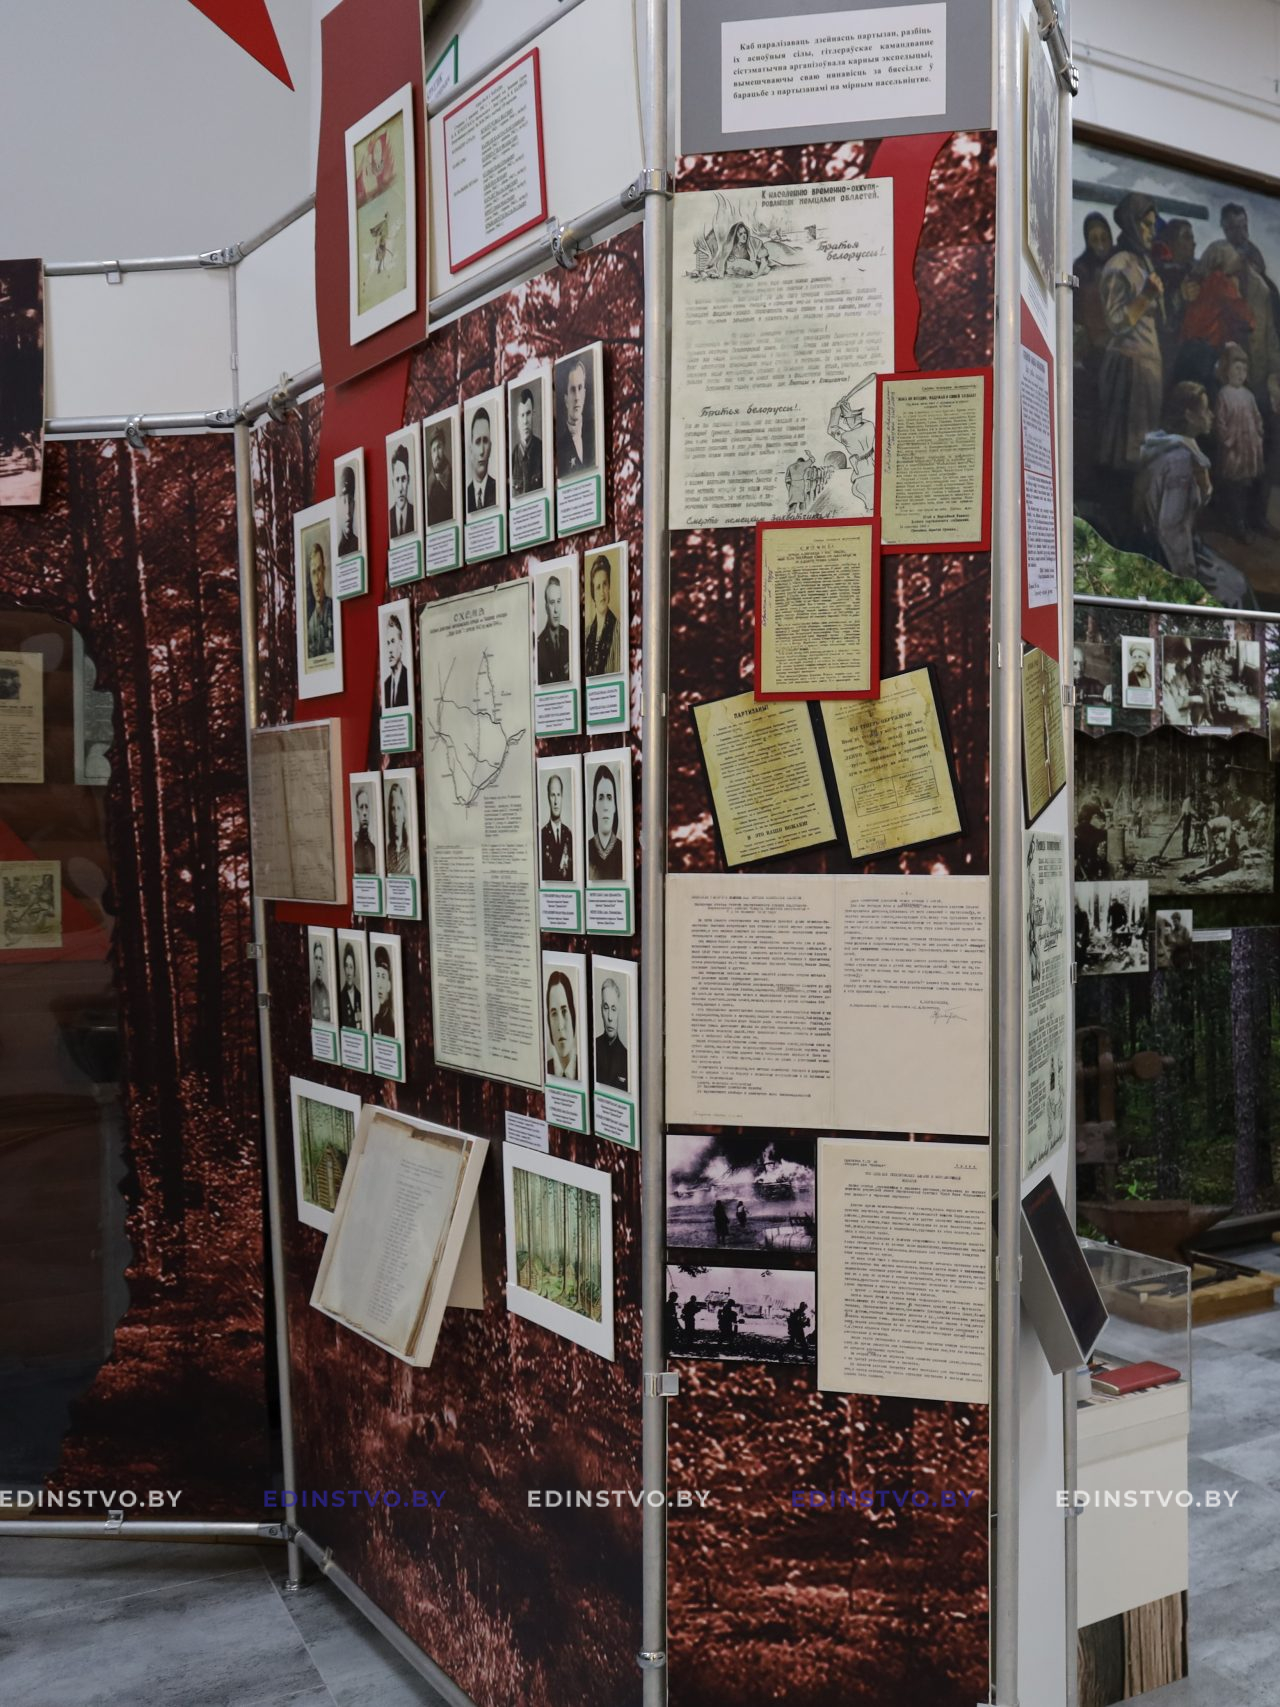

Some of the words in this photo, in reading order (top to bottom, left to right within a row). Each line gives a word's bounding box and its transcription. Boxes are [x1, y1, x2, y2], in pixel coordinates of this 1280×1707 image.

[740, 42, 755, 50] Каб
[757, 39, 810, 50] паралізаваць
[857, 31, 899, 40] партызан,
[901, 27, 932, 38] разбіць
[777, 84, 828, 96] партызанамі
[842, 81, 873, 91] мірным
